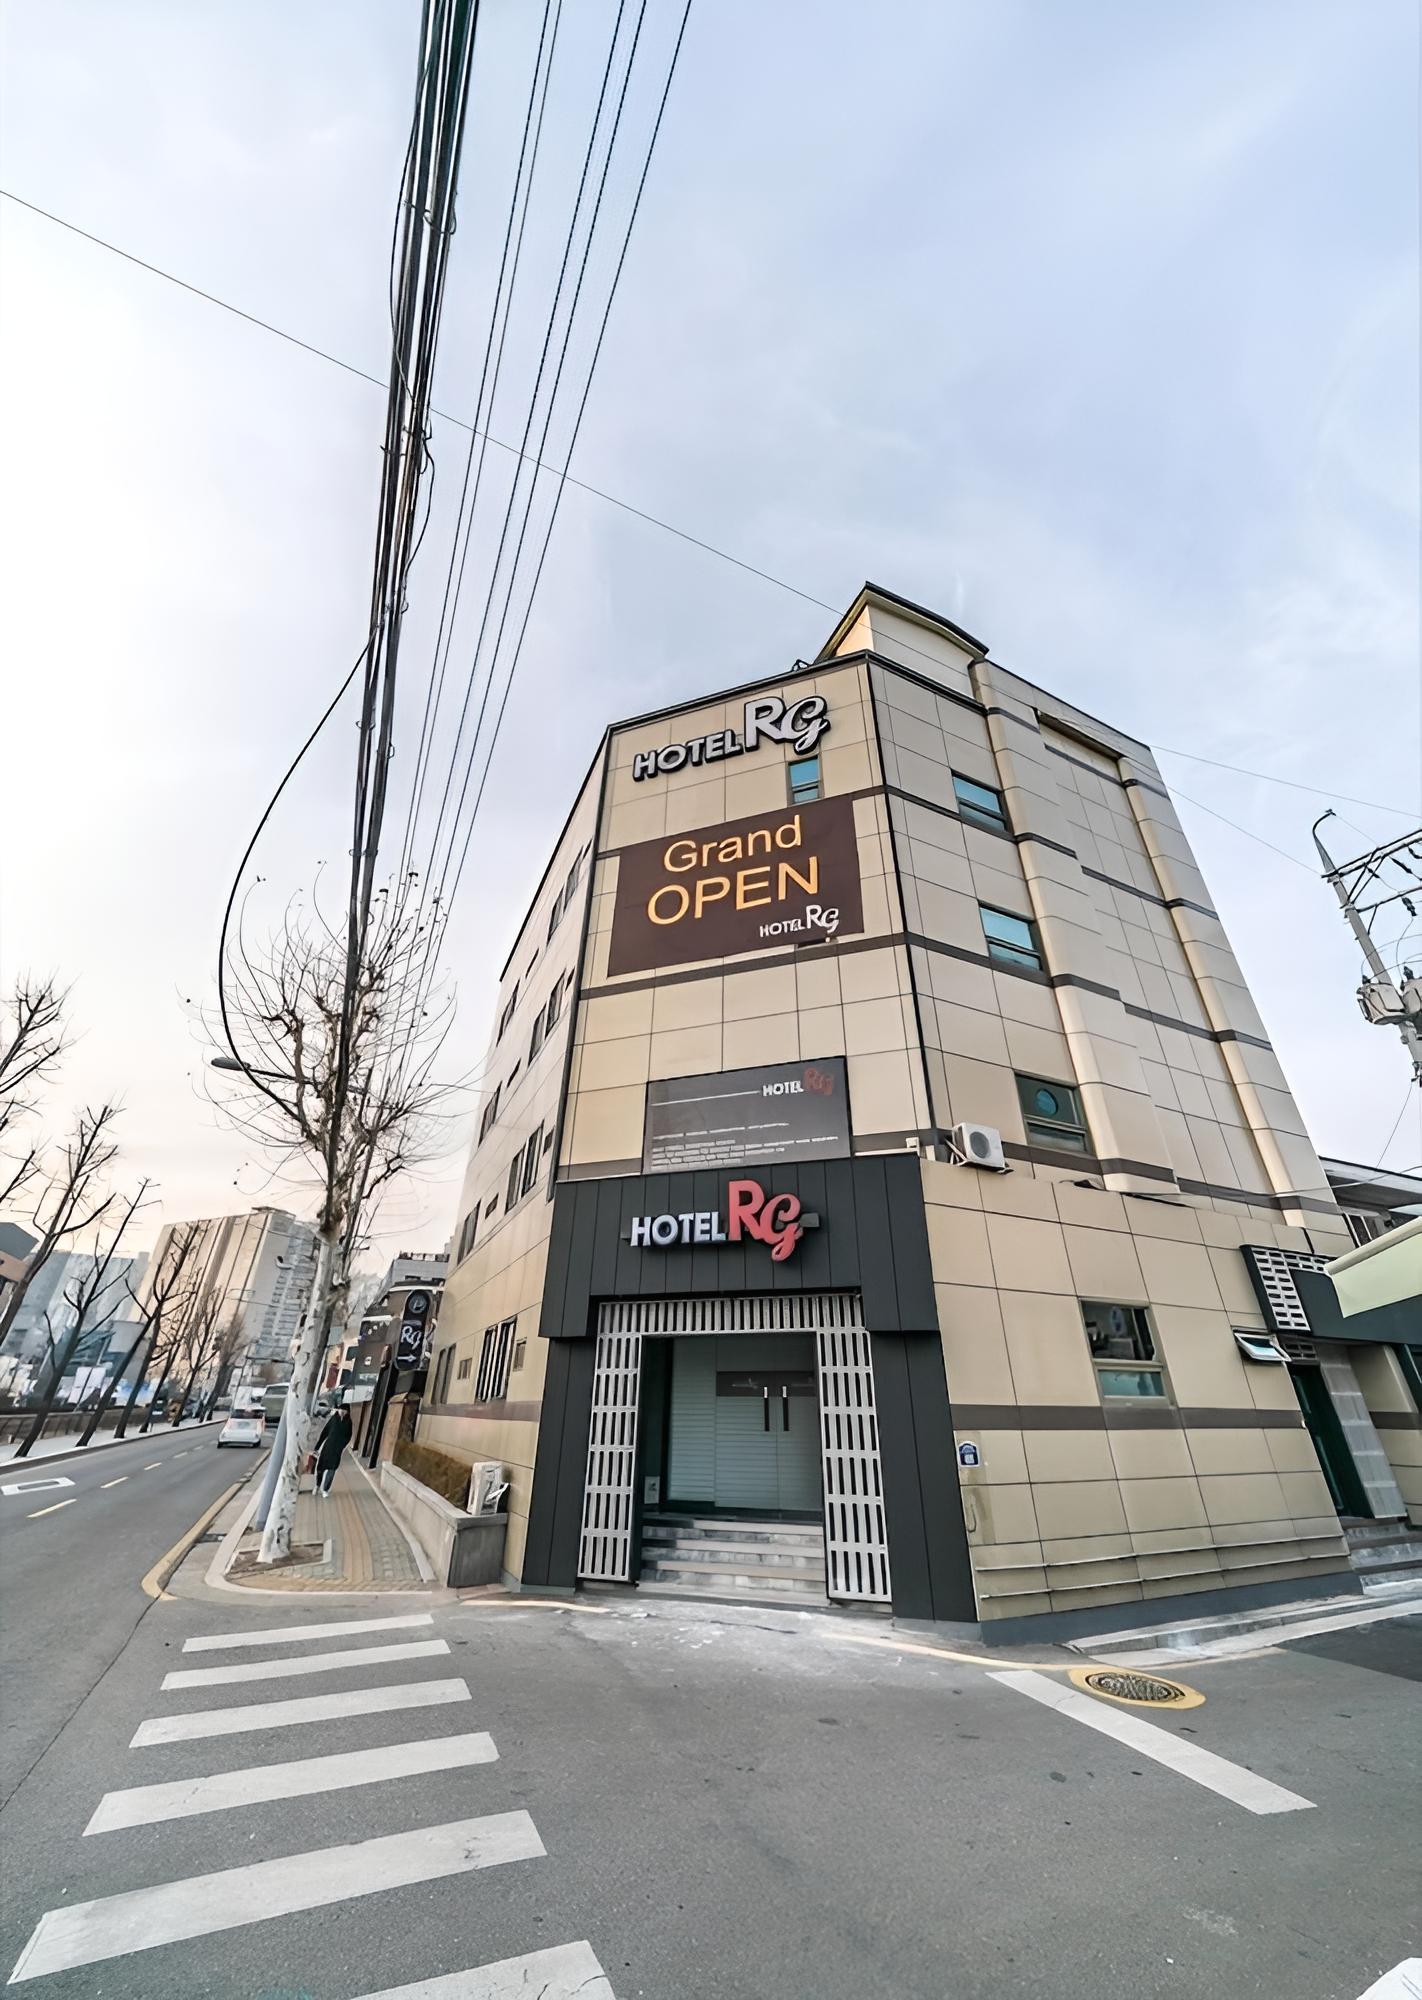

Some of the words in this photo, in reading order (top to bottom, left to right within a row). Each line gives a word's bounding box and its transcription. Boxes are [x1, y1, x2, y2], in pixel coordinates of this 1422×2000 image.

[633, 730, 743, 781] HOTEL
[664, 815, 802, 873] Grand
[647, 856, 819, 925] OPEN
[759, 918, 806, 938] HOTEL
[762, 1080, 804, 1097] HOTEL
[630, 1211, 728, 1247] HOTEL
